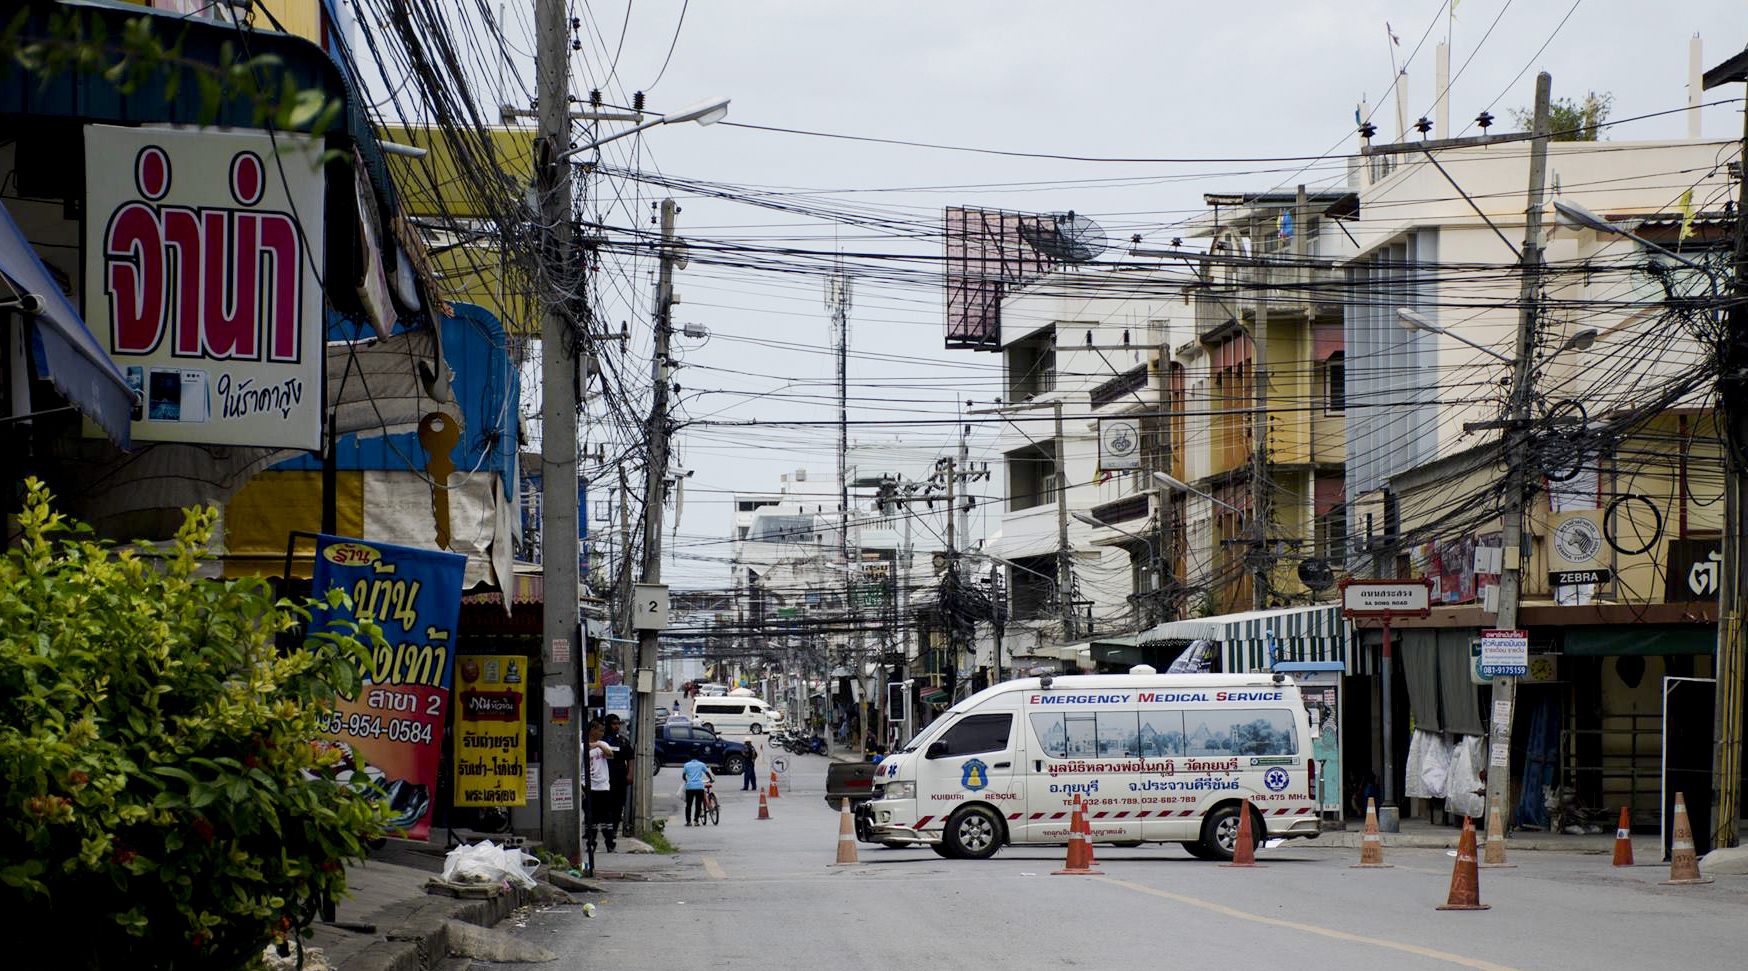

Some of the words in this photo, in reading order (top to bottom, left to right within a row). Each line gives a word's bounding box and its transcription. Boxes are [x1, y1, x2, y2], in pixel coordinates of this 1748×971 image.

[103, 145, 303, 364] จำนำ
[217, 373, 302, 419] ให้ราคาสูง
[332, 543, 370, 564] ร้าน
[1559, 571, 1599, 583] ZEBRA
[352, 559, 421, 632] บ้าน
[648, 600, 659, 613] 2
[1483, 666, 1526, 674] 081-9175159
[367, 689, 417, 713] สาขา
[426, 695, 441, 715] 2
[1029, 694, 1131, 704] EMERGENCY
[1138, 693, 1210, 703] MEDICAL
[1216, 691, 1284, 701] SERVICE
[463, 731, 519, 753] รับถ่ายรูป
[1184, 758, 1239, 776] วัดกุยบุรี
[464, 780, 517, 802] พระเครื่อง
[931, 793, 965, 801] KUIBURI
[1049, 780, 1099, 797] อ.กุยบุรี
